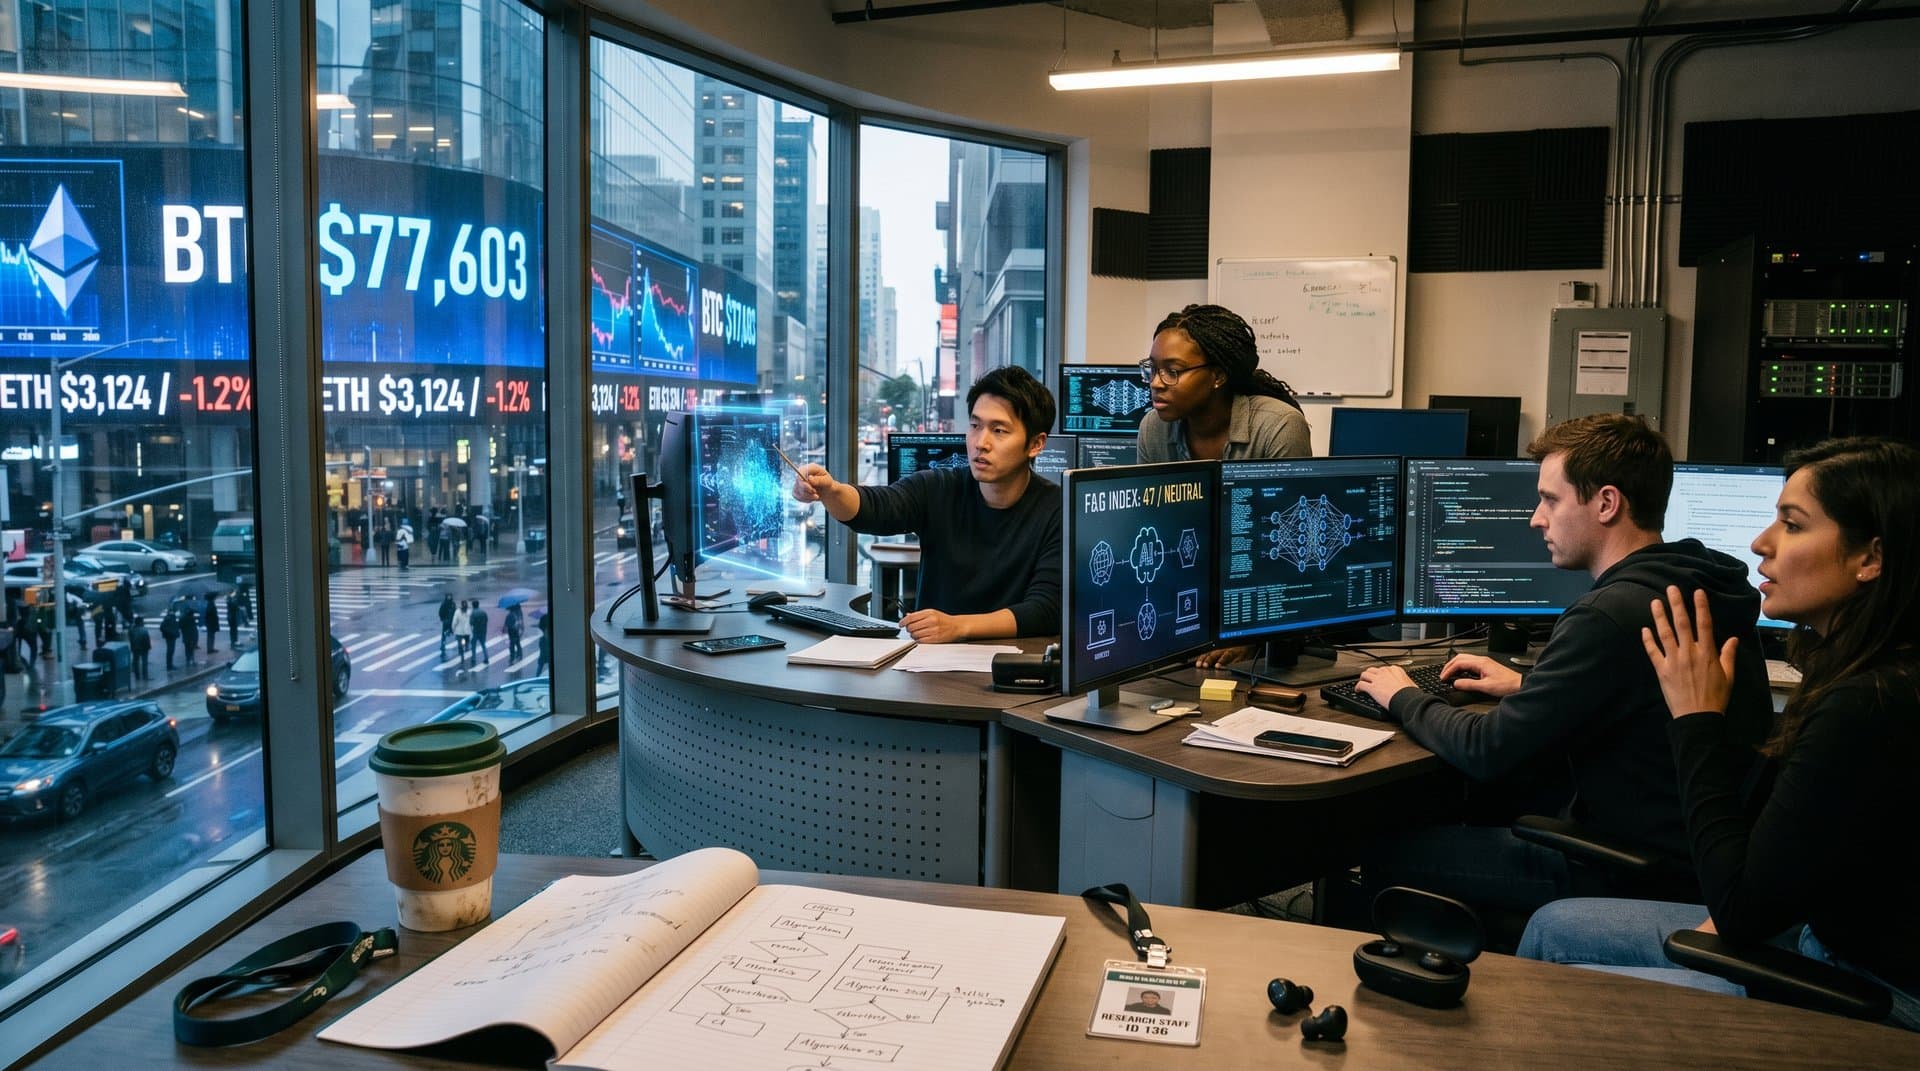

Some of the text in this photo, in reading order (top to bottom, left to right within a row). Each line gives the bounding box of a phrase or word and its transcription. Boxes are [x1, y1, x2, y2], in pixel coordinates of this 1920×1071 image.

[163, 203, 527, 307] BT $77,603
[702, 287, 723, 337] BTC
[0, 374, 52, 410] ETH
[60, 371, 151, 416] $3,124
[158, 372, 171, 415] /
[379, 374, 464, 418] $3,124
[469, 377, 480, 417] /
[486, 381, 530, 413] -1.2%
[1085, 482, 1204, 513] F&G INDEX: 47 / NEUTRAL
[1101, 1013, 1191, 1028] RESEARCH STAFF
[1125, 1023, 1169, 1036] ID 136
